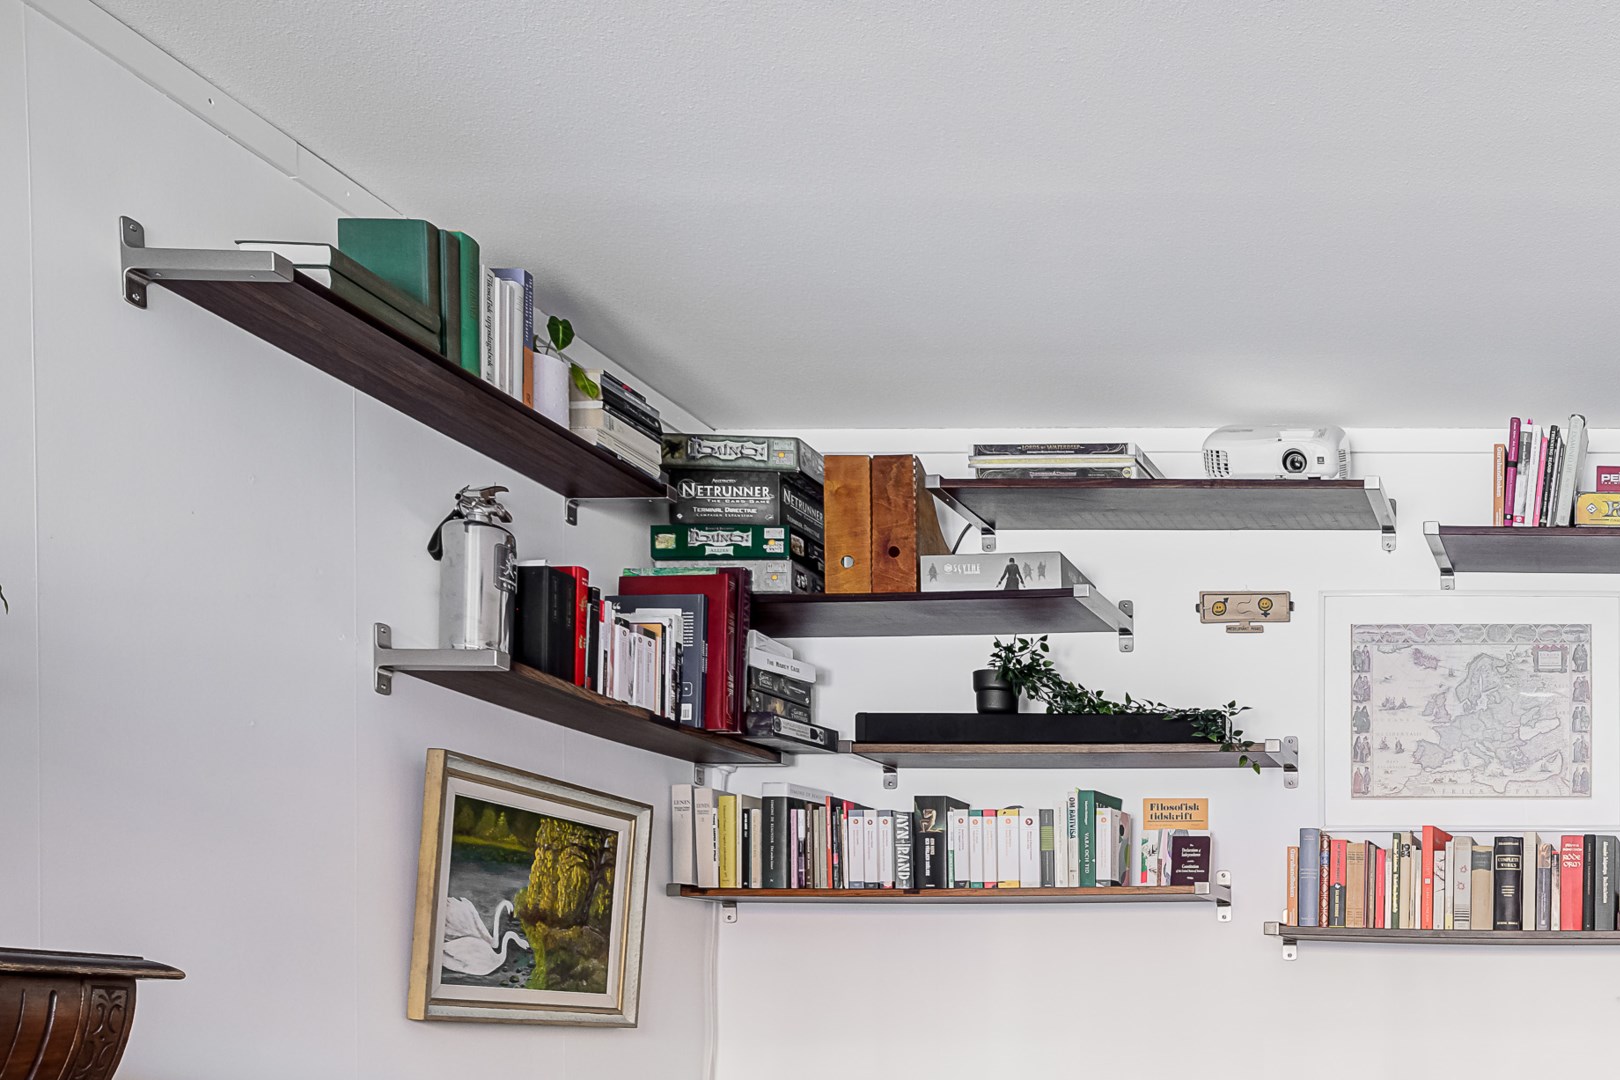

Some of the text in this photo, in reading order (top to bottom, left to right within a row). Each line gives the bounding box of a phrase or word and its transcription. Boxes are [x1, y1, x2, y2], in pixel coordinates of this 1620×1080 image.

[485, 273, 494, 366] Filosofisk uppslagsbok
[682, 482, 770, 498] NETRUNNER
[952, 562, 981, 575] SCYTHE
[1069, 797, 1075, 808] OM
[1150, 803, 1199, 811] Filosofisk
[1150, 812, 1193, 820] tidskrift
[896, 814, 911, 880] AYN RAND
